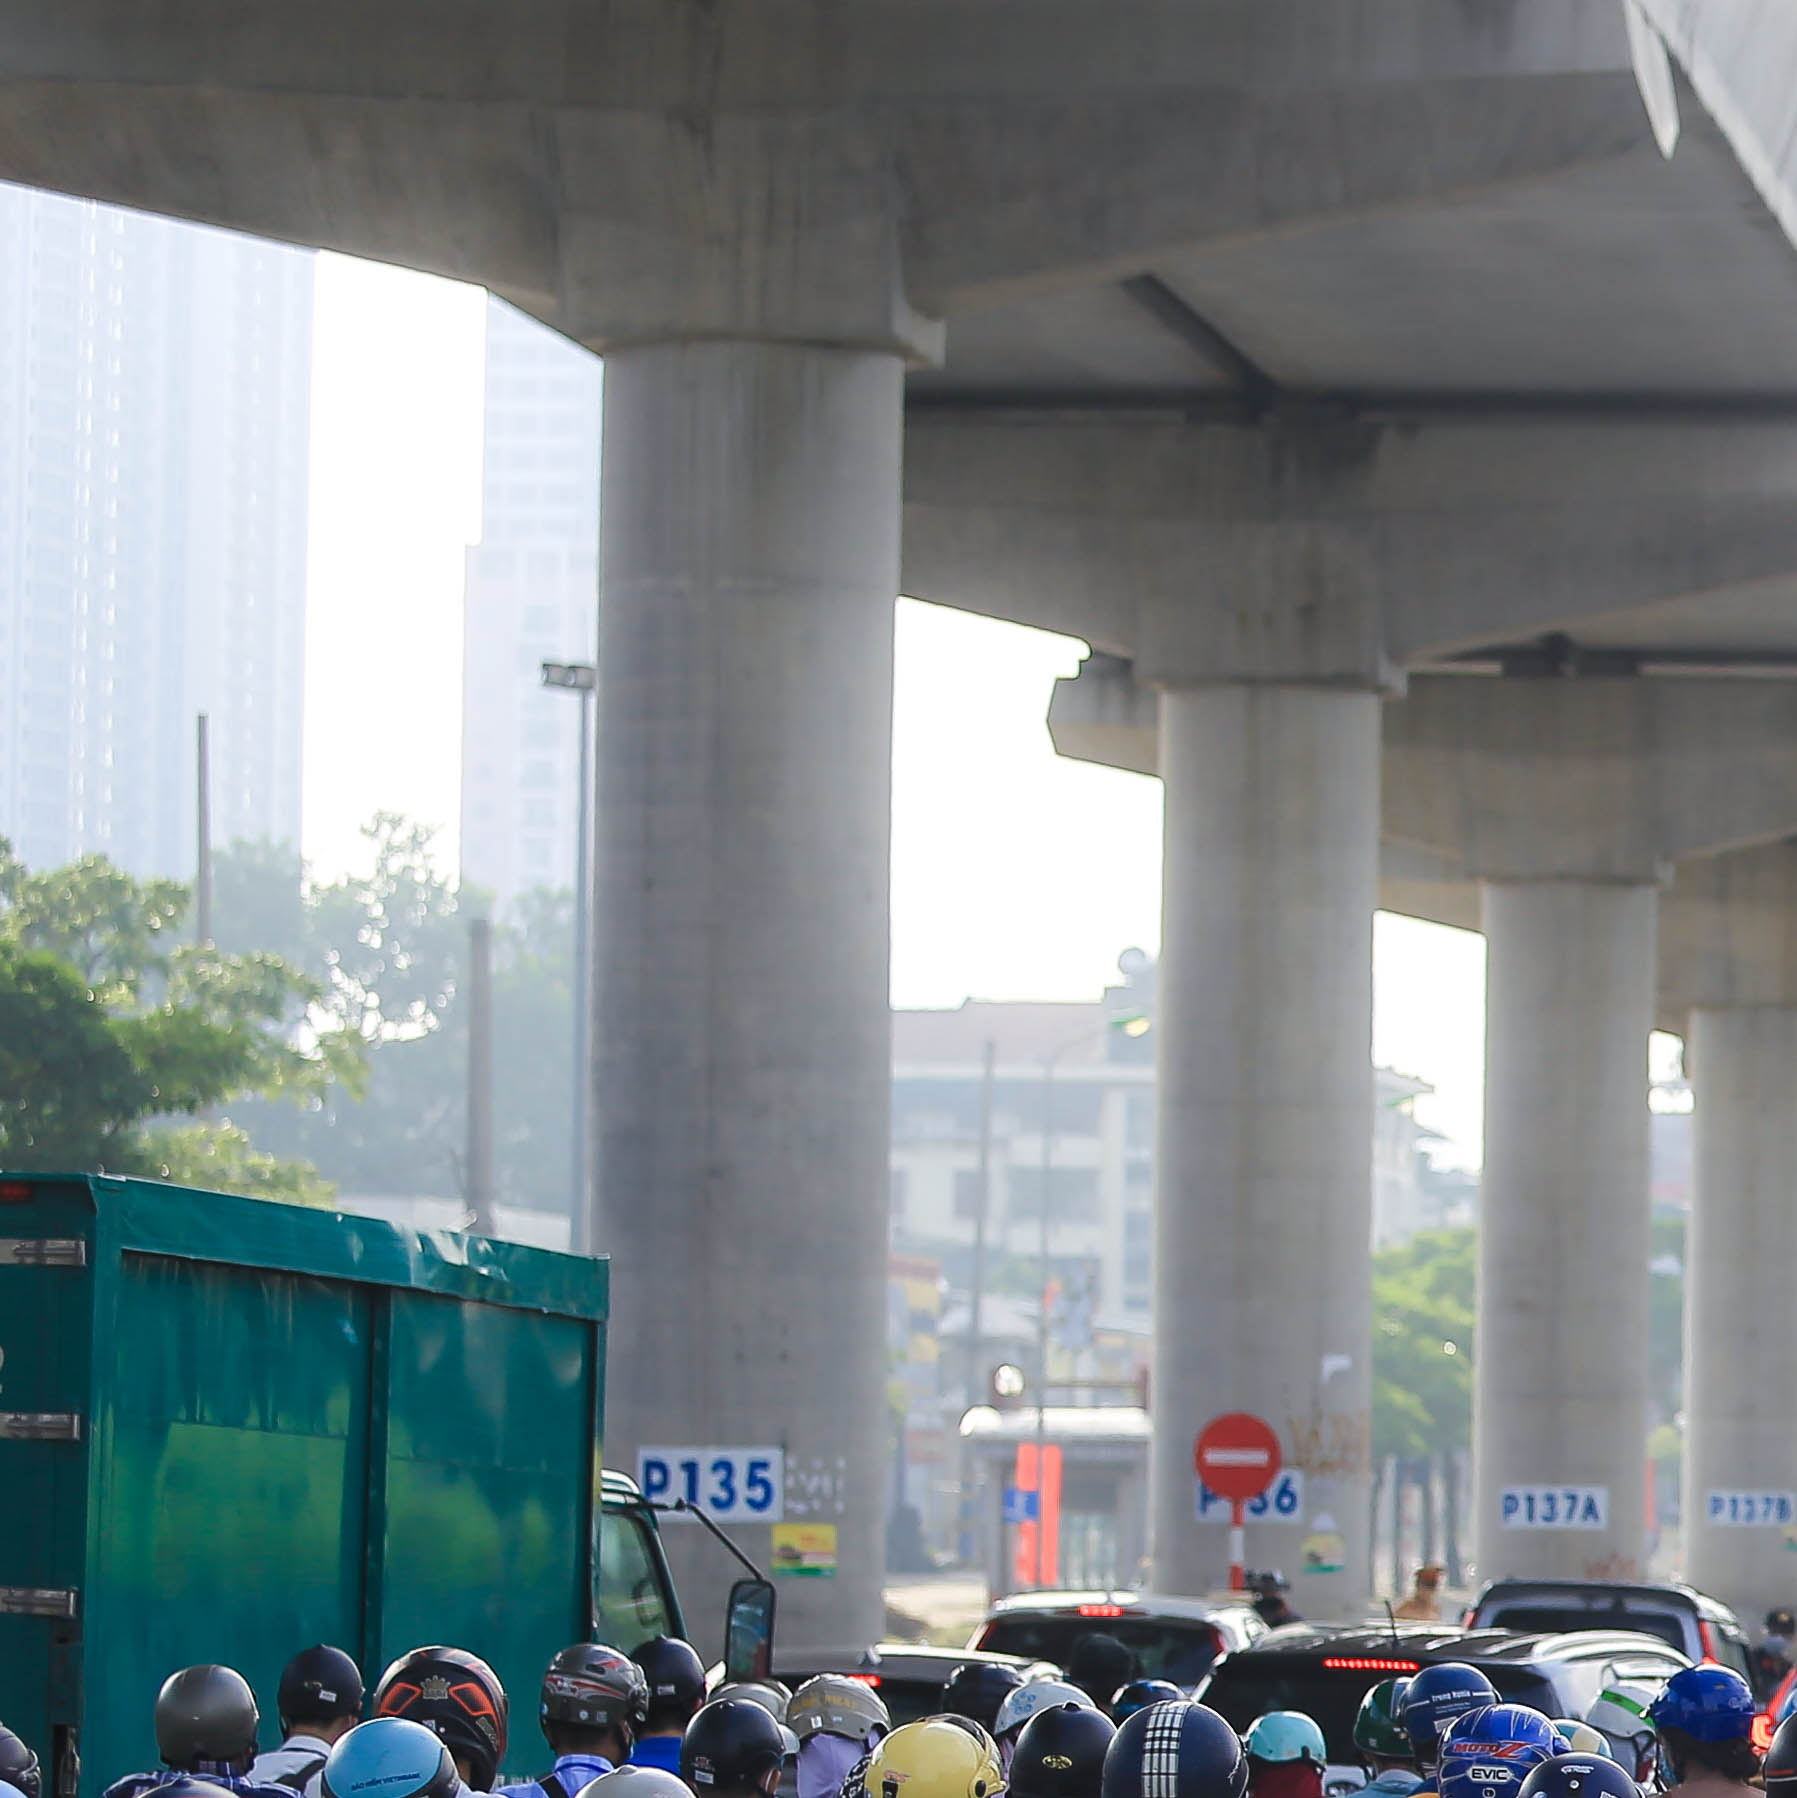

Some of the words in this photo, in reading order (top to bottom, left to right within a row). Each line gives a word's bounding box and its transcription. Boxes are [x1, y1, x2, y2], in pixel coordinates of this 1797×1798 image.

[643, 1458, 775, 1512] P135
[1503, 1493, 1600, 1523] P137A
[1471, 1767, 1509, 1781] EVIC
